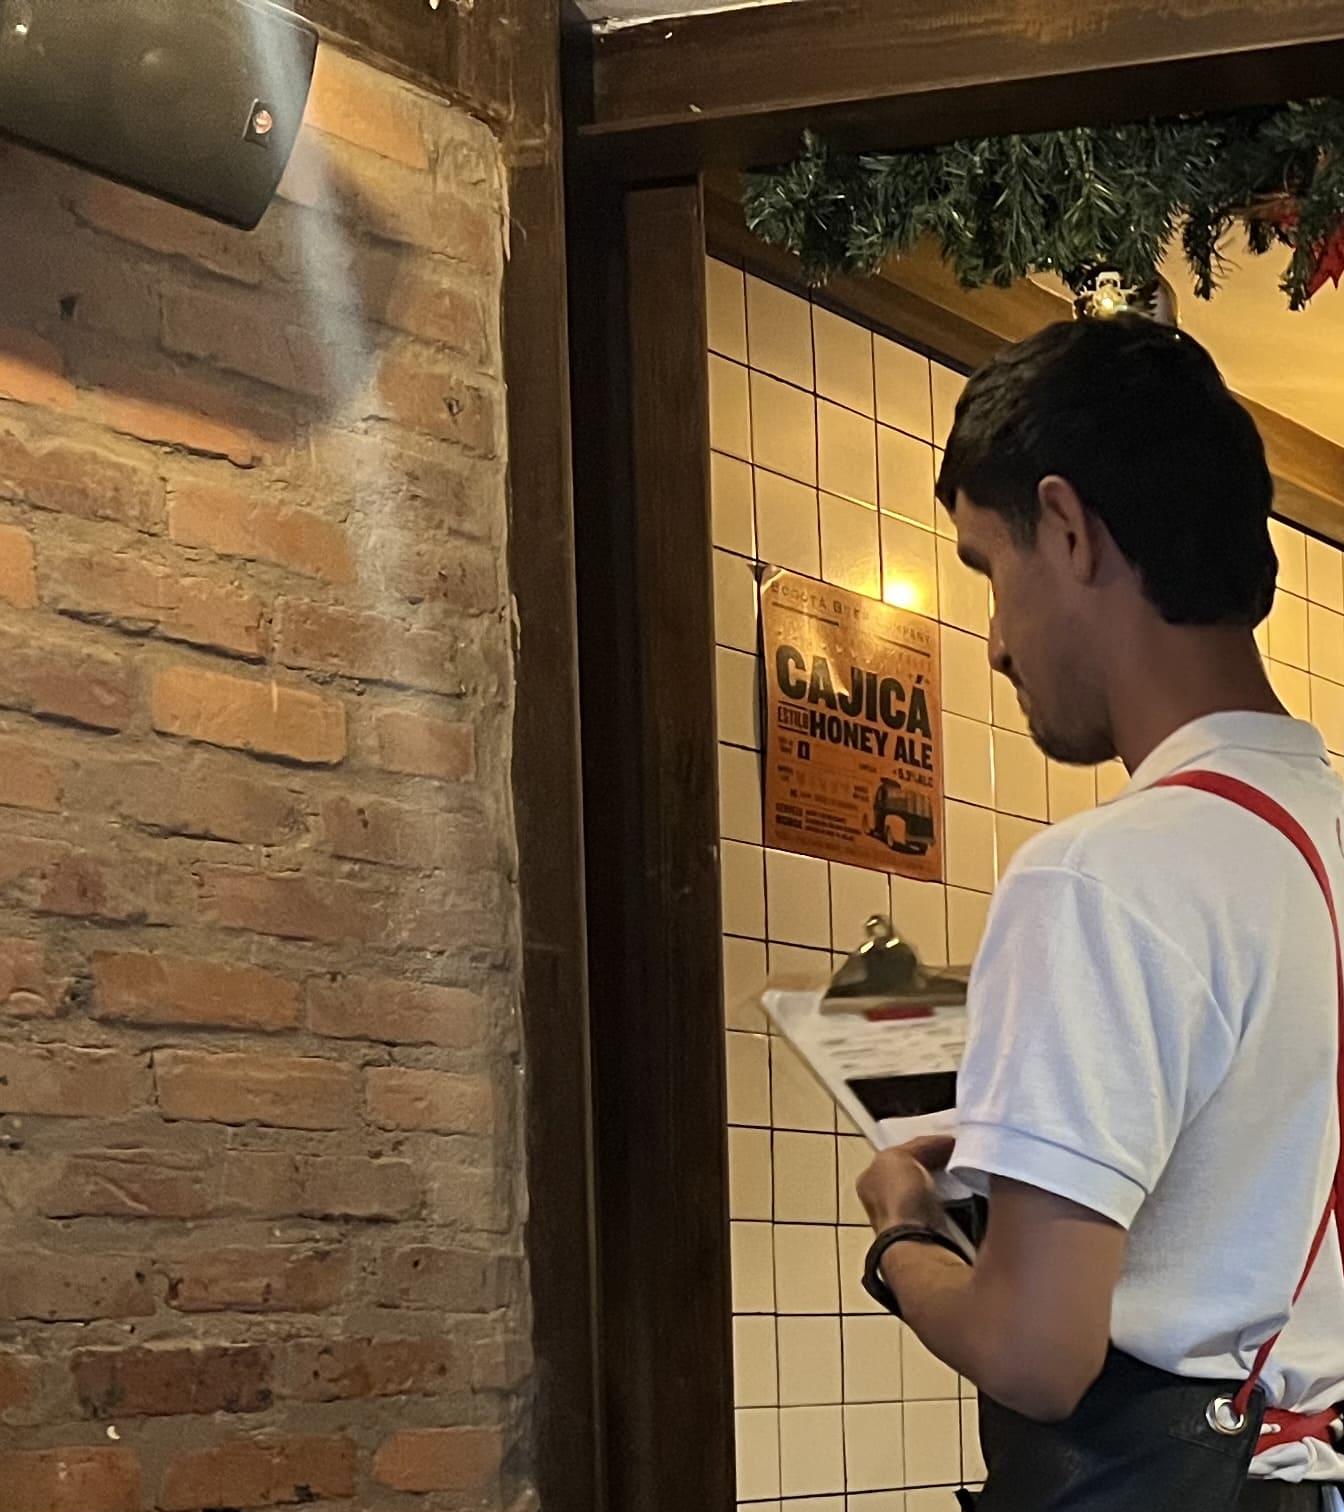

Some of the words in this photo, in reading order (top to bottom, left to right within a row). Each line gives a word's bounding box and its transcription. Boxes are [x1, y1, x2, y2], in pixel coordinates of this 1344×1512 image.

[776, 644, 932, 740] CAJICÁ
[810, 709, 889, 757] HONEY
[894, 735, 933, 772] ALE
